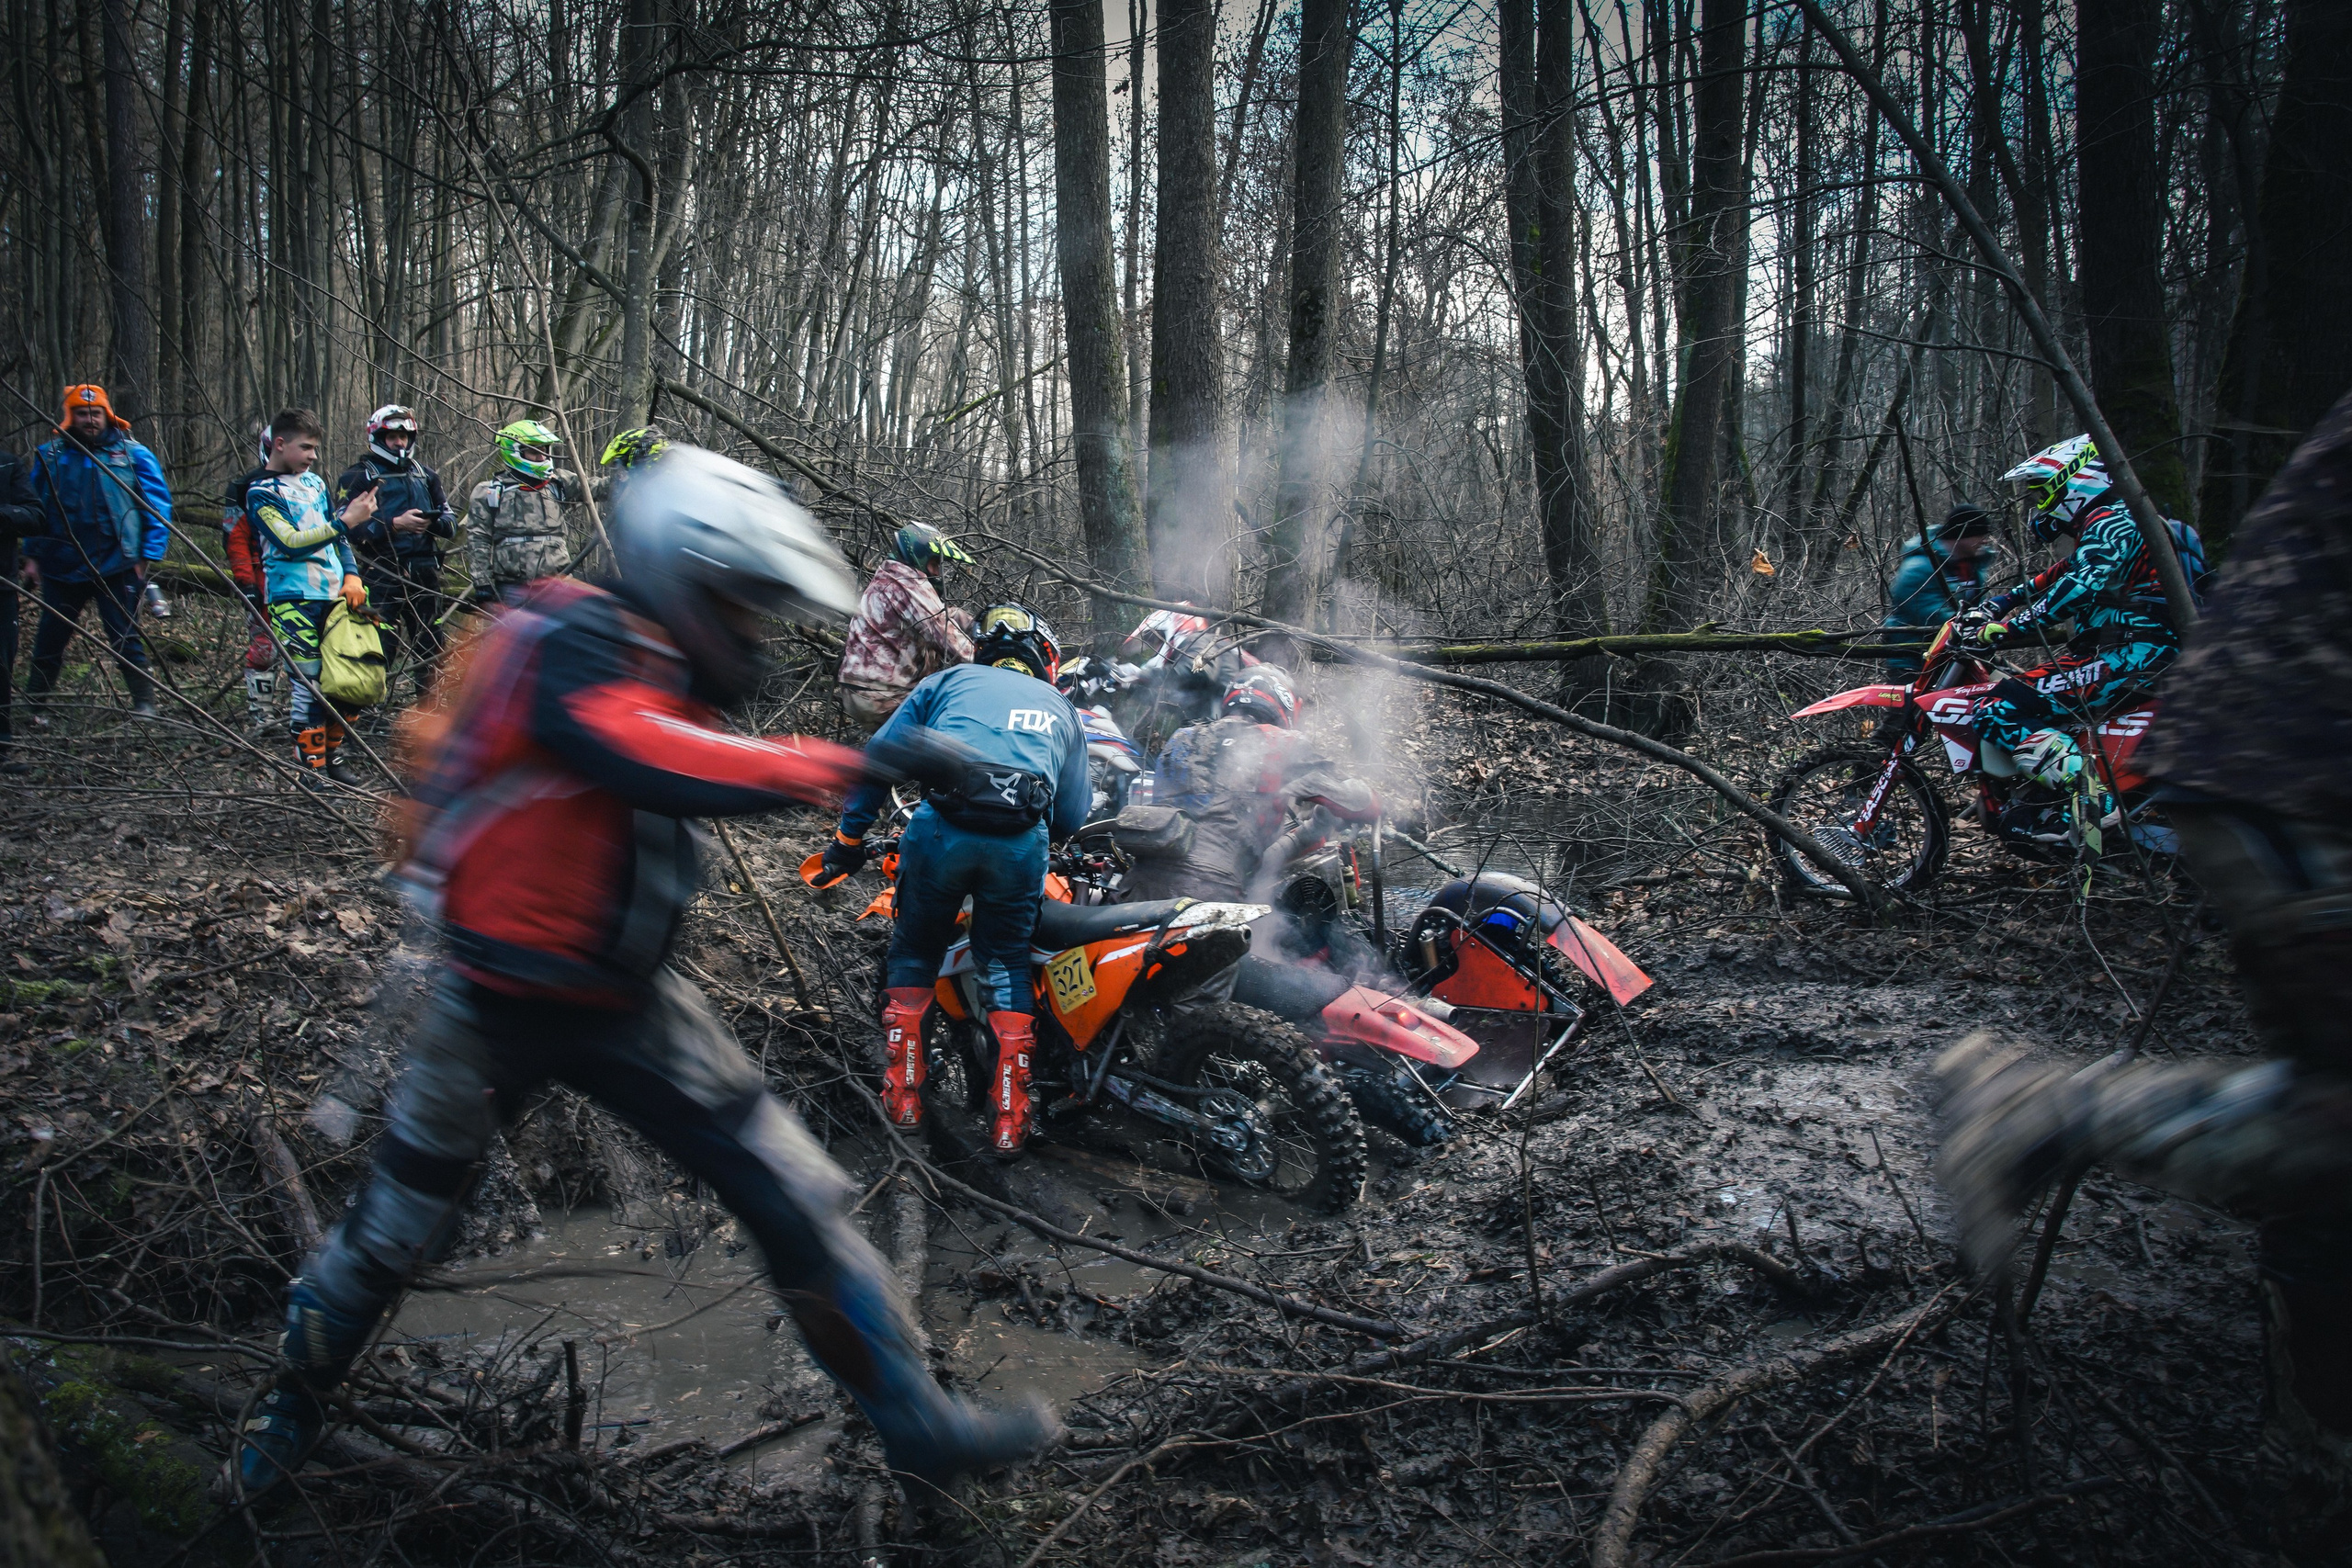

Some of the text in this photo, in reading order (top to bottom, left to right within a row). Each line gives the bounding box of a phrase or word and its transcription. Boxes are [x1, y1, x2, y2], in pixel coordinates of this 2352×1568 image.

[2048, 446, 2097, 491] 100%
[1954, 686, 1972, 696] Troy
[1007, 708, 1058, 735] FOX
[1052, 956, 1084, 997] 527
[888, 1028, 903, 1043] G
[1018, 1053, 1030, 1068] G
